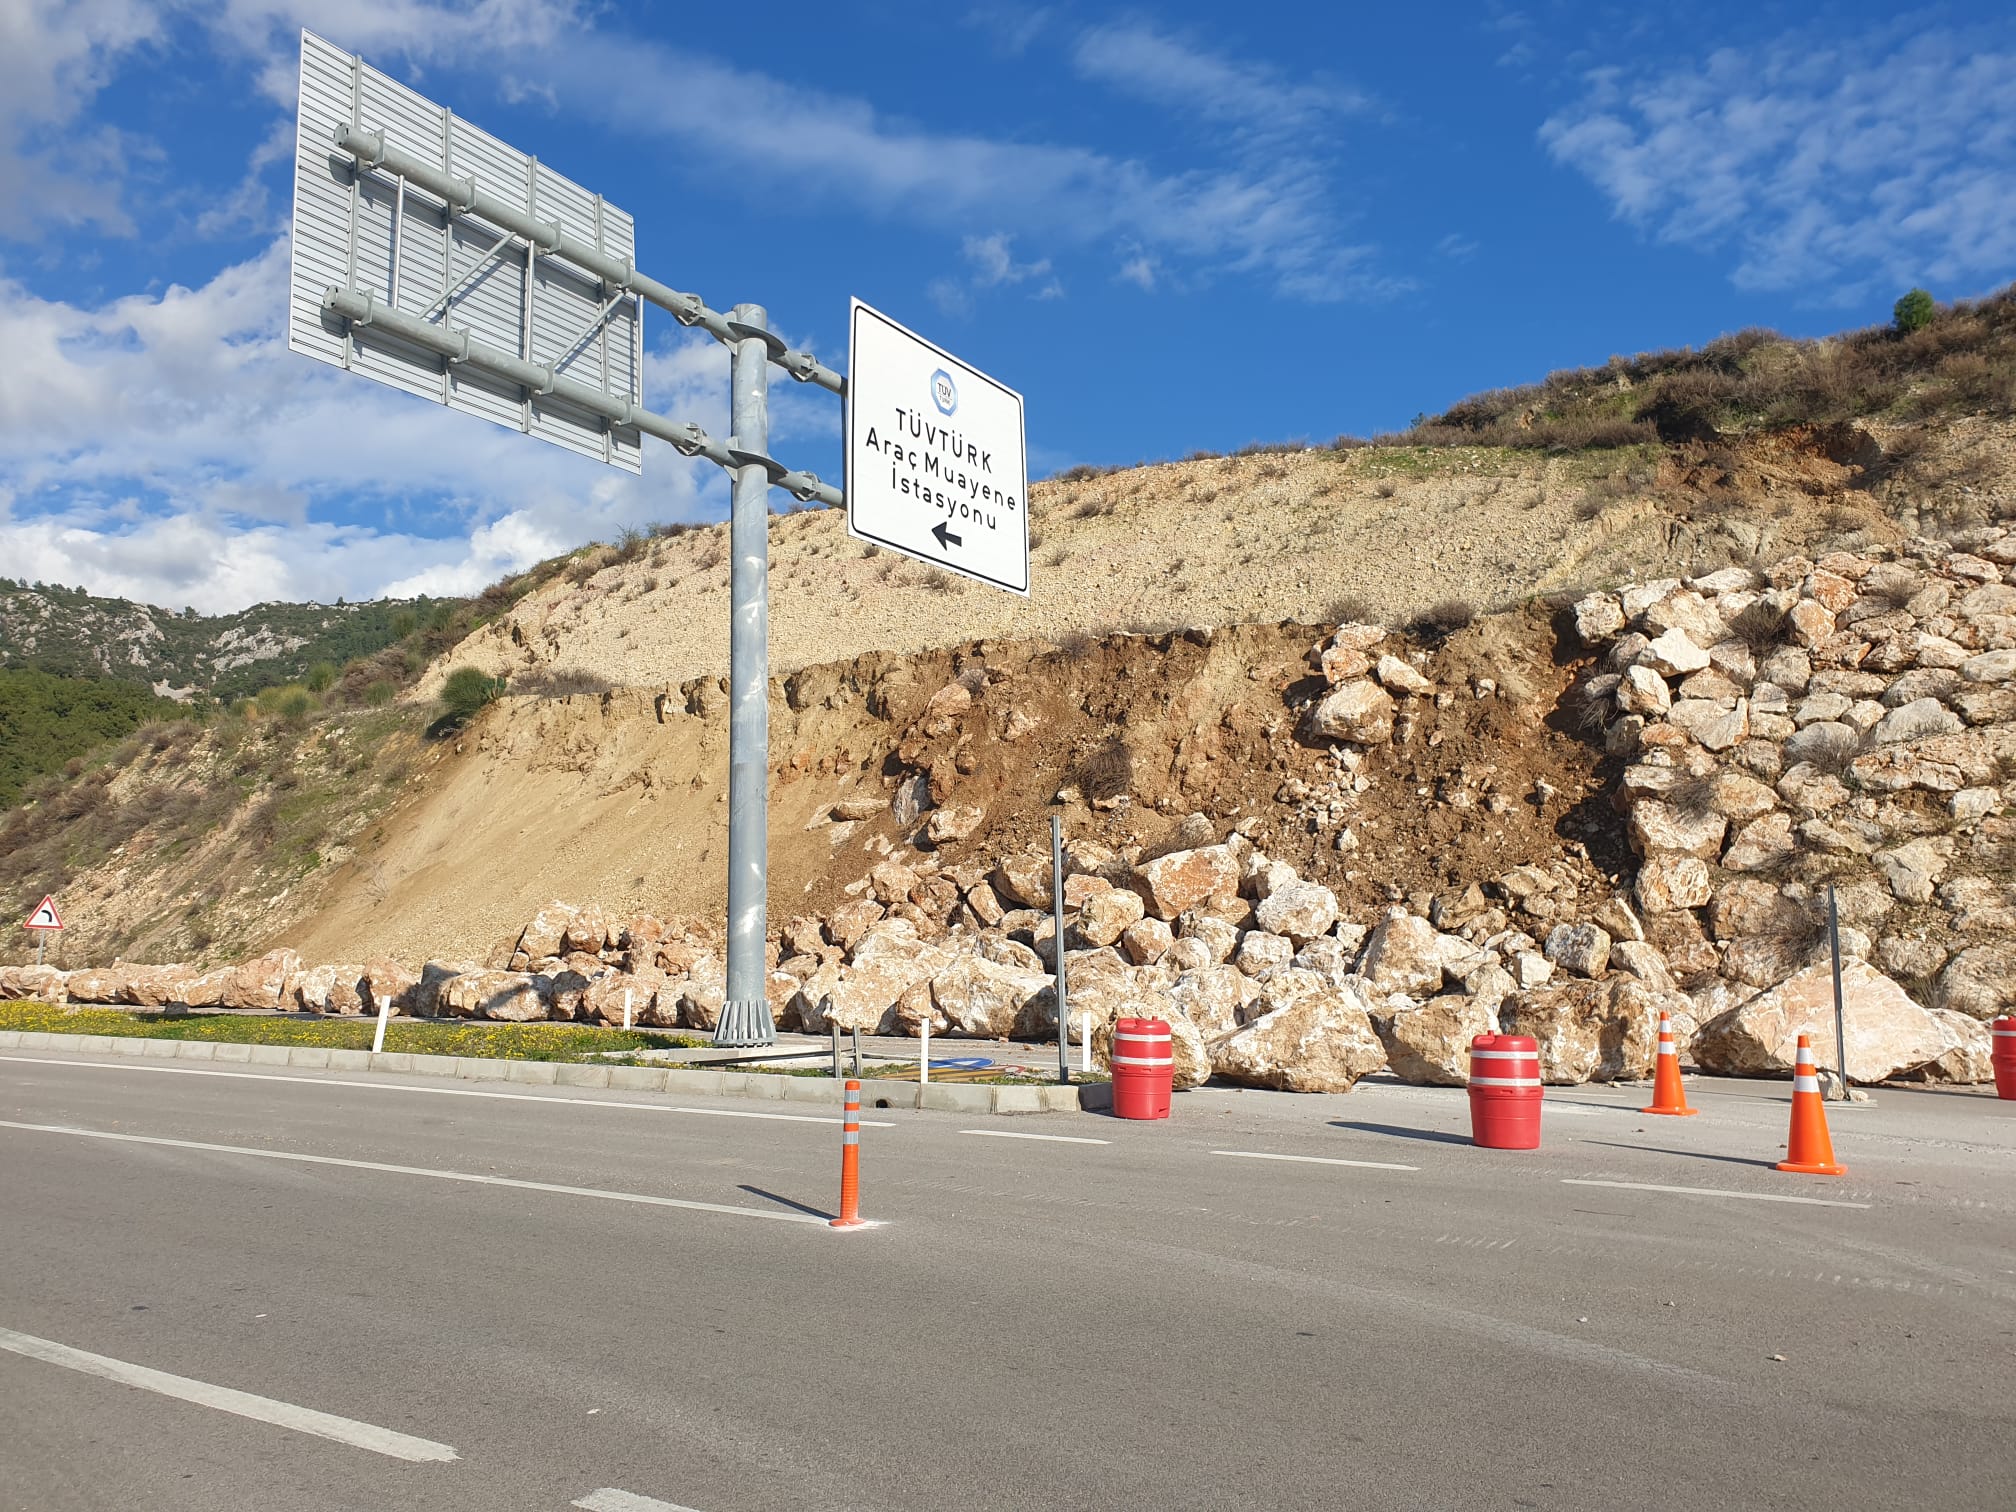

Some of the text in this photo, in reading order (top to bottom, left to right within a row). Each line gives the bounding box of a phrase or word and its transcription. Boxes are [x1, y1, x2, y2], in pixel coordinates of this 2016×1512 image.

[866, 427, 1016, 511] Araç Muayene
[895, 407, 992, 474] TÜVTÜRK
[892, 461, 996, 530] İstasyonu
